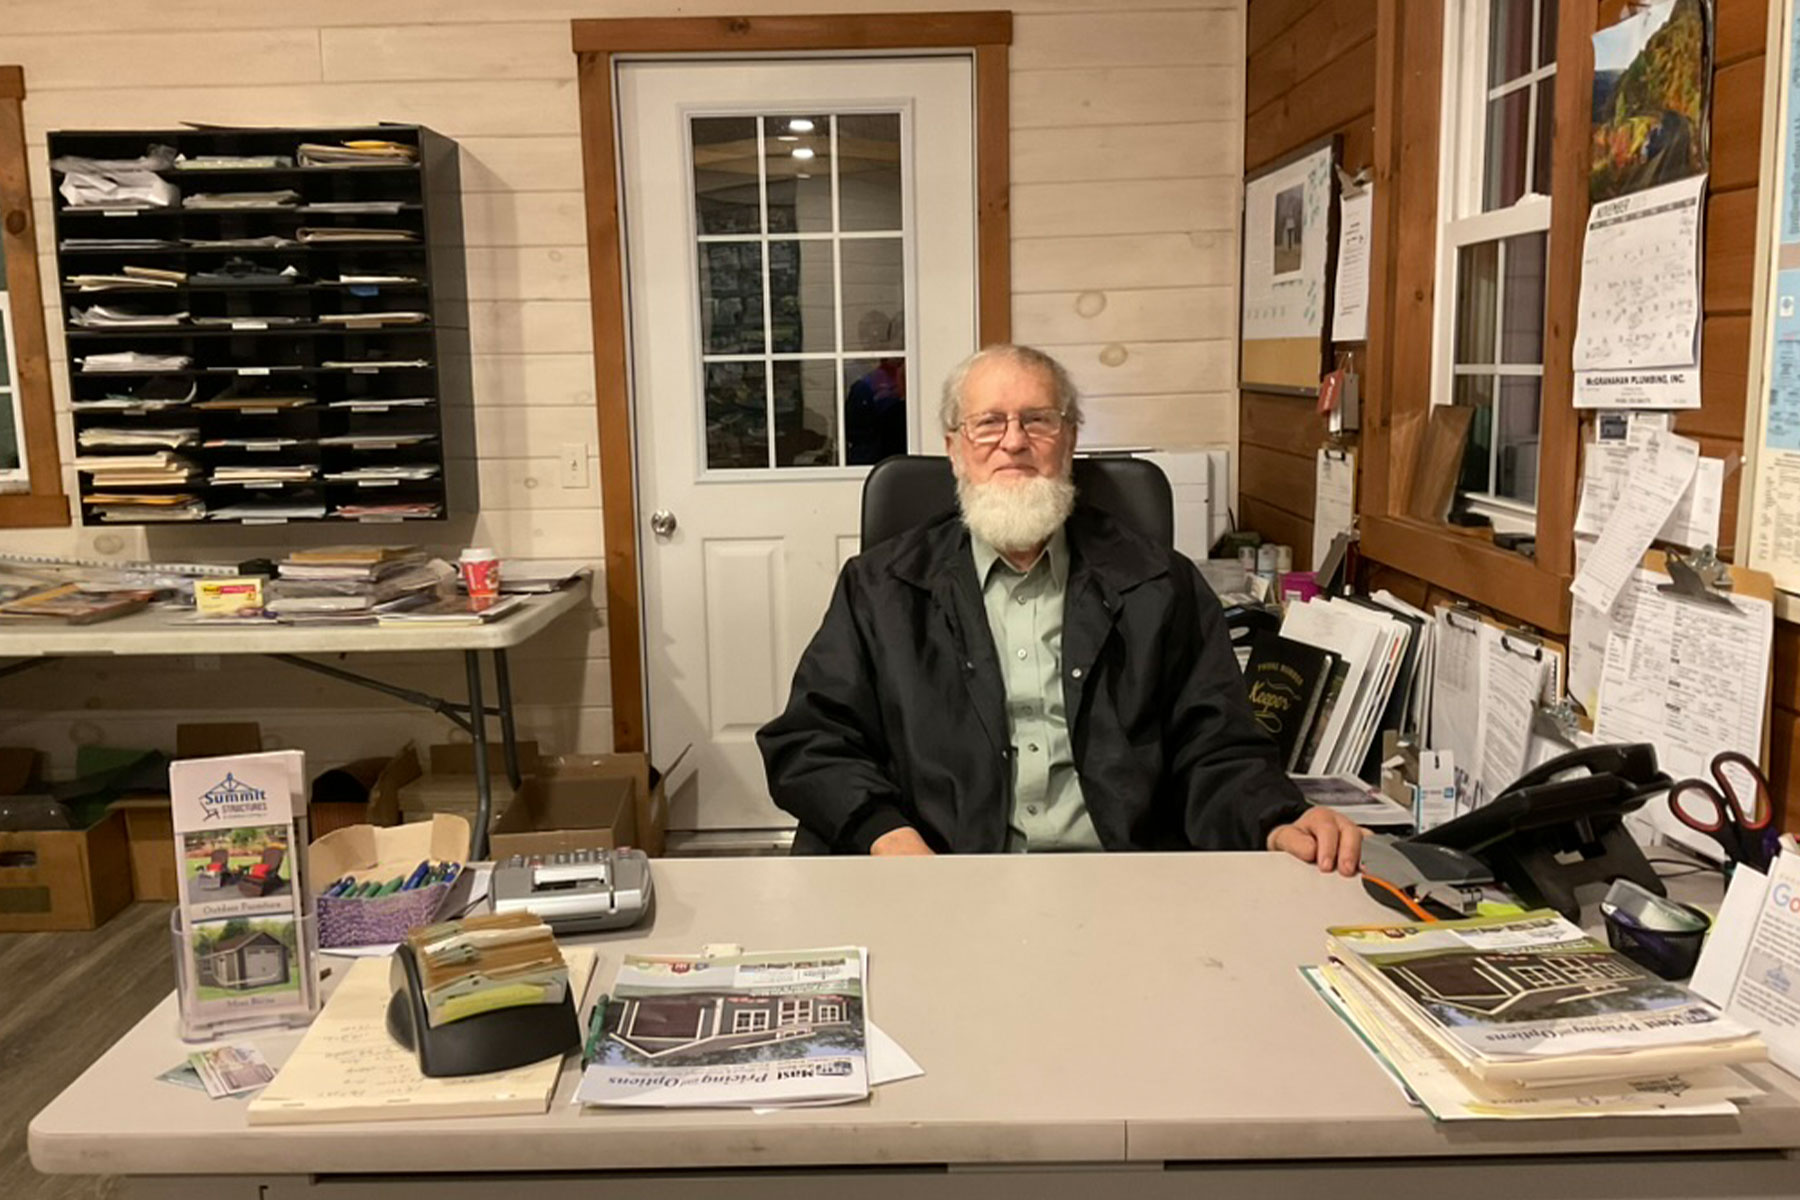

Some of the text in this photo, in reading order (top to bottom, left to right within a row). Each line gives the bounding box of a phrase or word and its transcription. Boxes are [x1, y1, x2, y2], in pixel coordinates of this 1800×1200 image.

[204, 788, 267, 805] Summit
[222, 802, 268, 813] STRUCTURES
[1573, 1022, 1641, 1035] Pricing
[1645, 1016, 1683, 1029] Mast
[1486, 1029, 1557, 1043] Options
[701, 1072, 768, 1085] Pricing
[777, 1069, 814, 1080] Mast
[608, 1076, 680, 1088] Options
